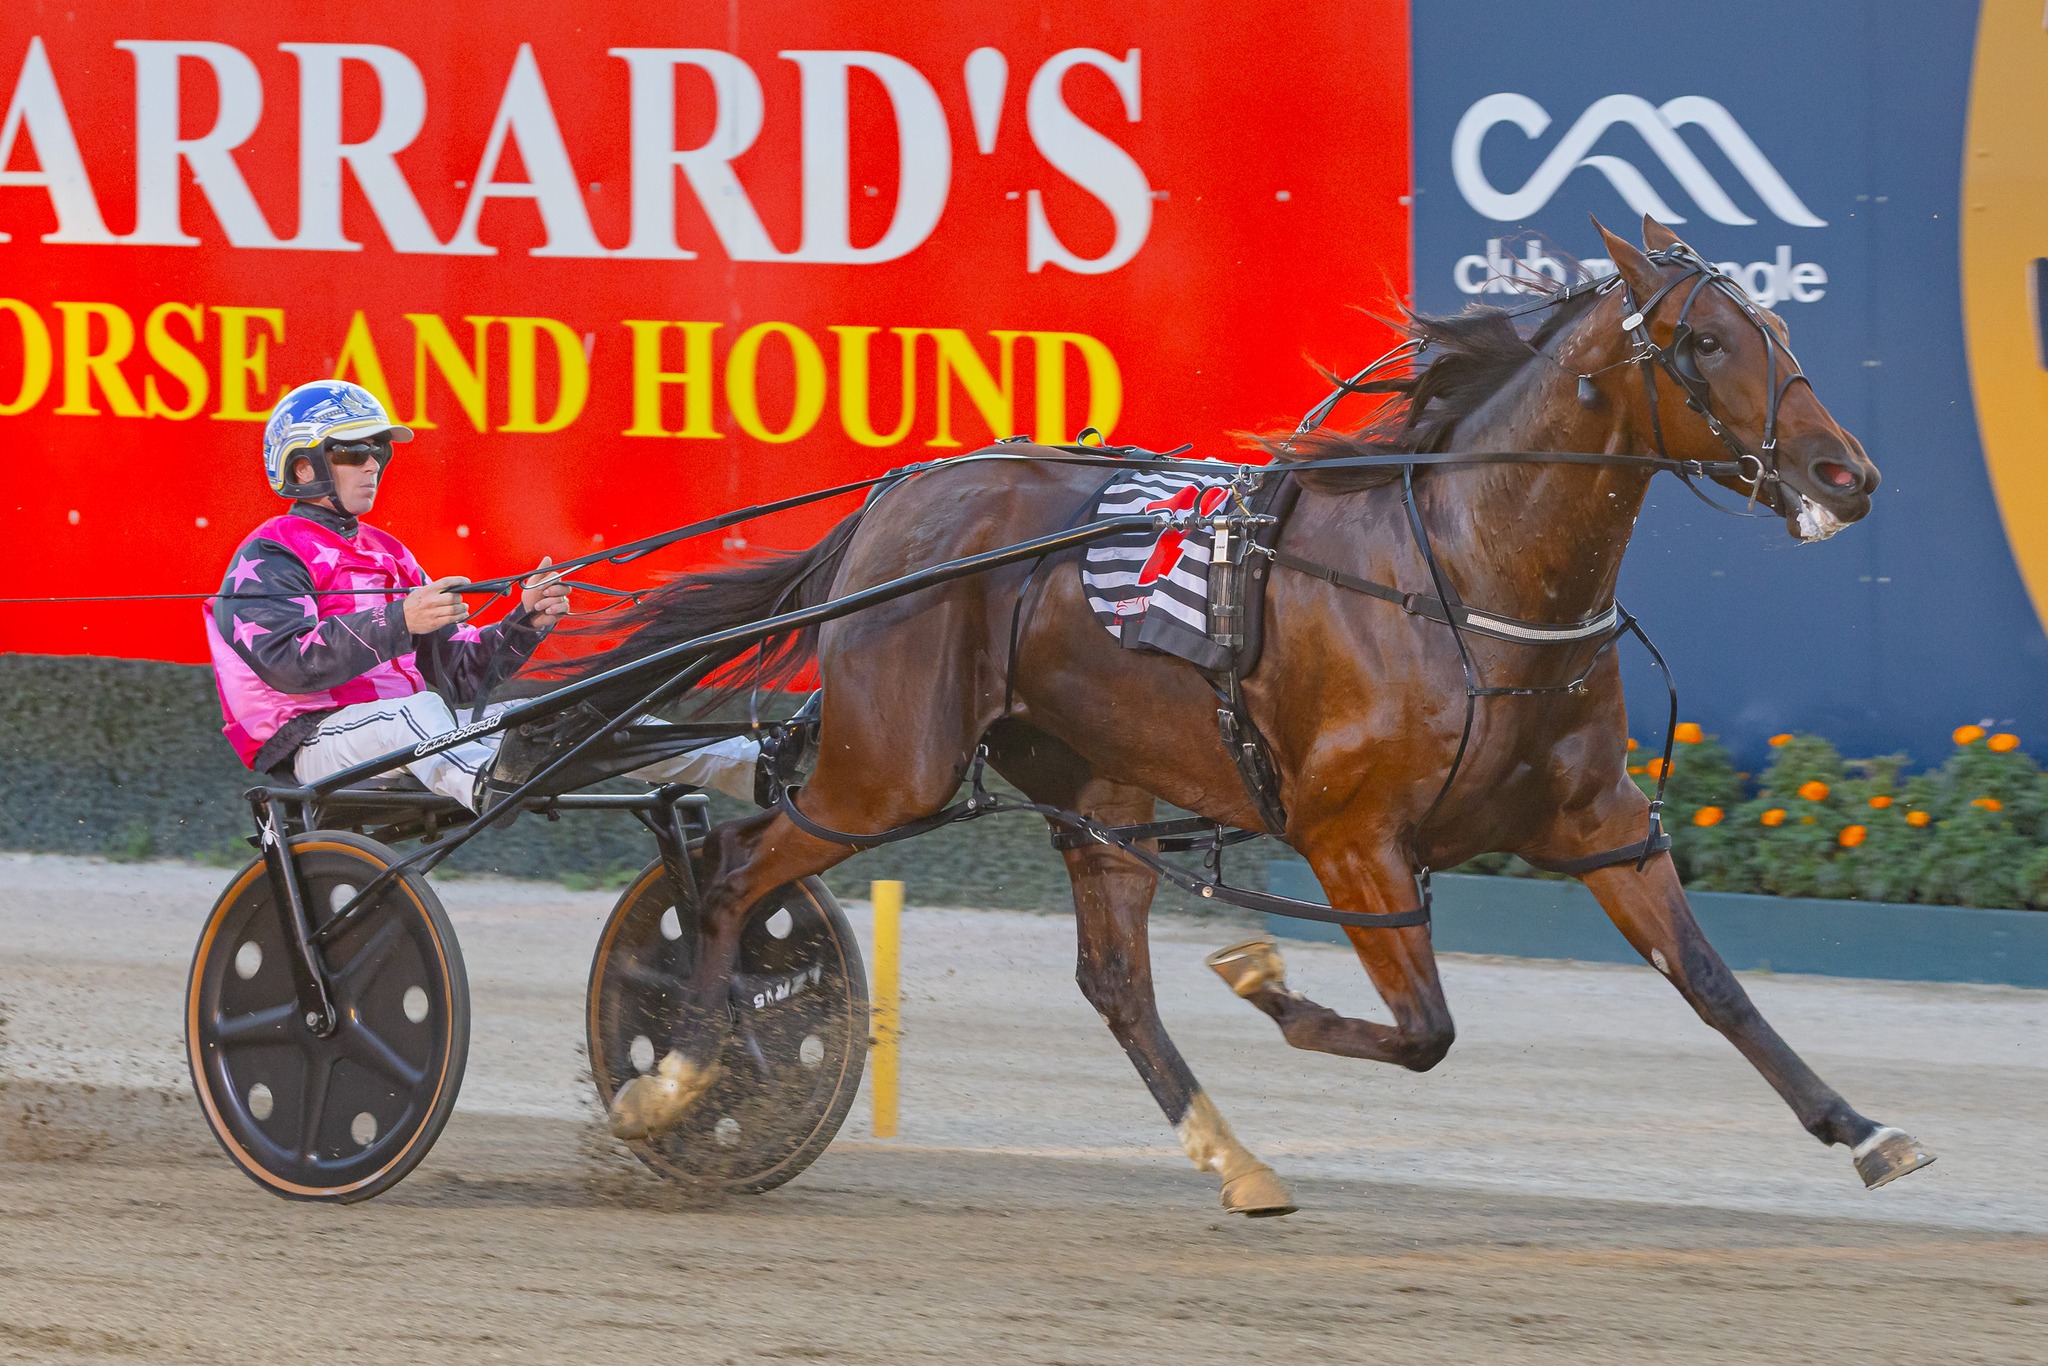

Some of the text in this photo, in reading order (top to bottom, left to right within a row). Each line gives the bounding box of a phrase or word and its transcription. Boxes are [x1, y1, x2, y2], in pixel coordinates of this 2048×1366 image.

[1453, 238, 1567, 296] club
[330, 310, 590, 433] AND
[622, 319, 1123, 448] HOUND
